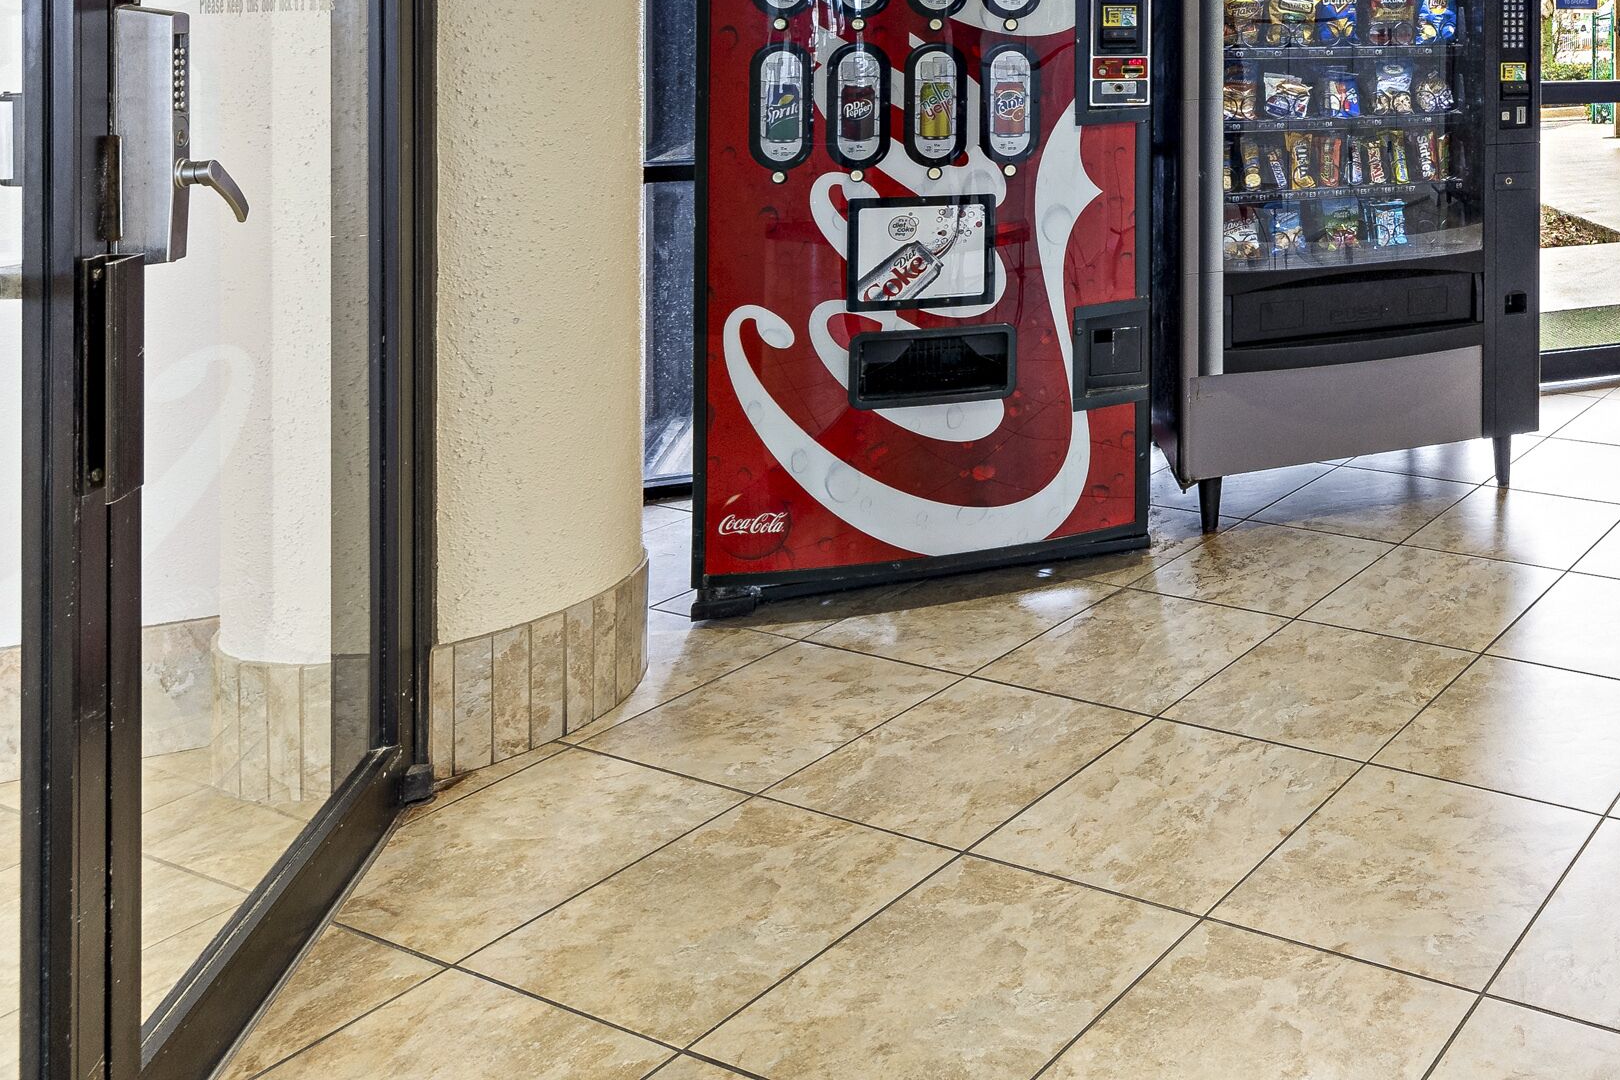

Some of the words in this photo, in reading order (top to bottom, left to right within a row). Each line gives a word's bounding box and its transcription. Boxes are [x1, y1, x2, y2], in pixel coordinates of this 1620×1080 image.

[844, 102, 873, 119] Pepper
[1417, 135, 1431, 178] Skittles
[893, 249, 917, 268] Diet
[863, 256, 928, 302] Coke
[718, 512, 788, 535] Coca-Cola
